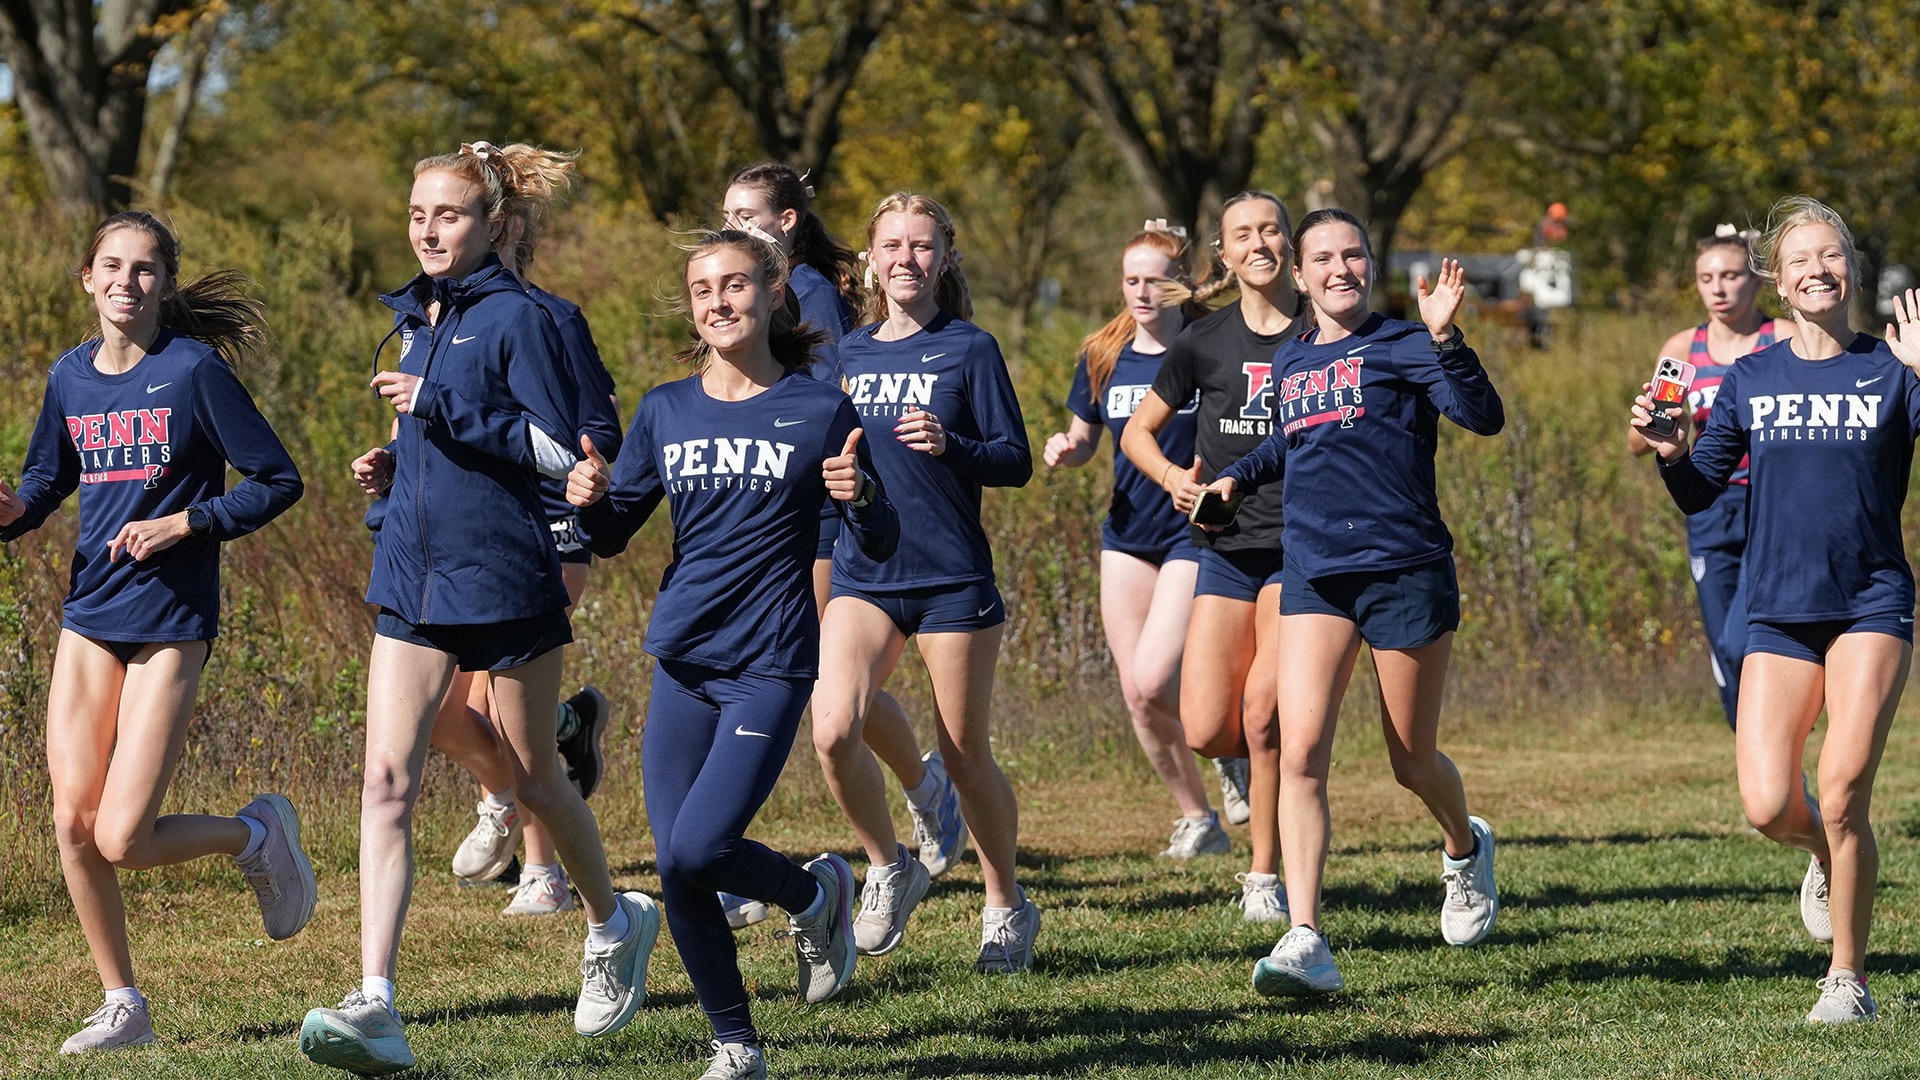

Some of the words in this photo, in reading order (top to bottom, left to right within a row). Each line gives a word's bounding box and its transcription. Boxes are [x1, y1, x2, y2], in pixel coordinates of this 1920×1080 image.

[1749, 393, 1883, 431] PENN
[1219, 418, 1254, 435] TRACK
[1257, 420, 1266, 436] &
[1759, 428, 1868, 442] ATHLETICS
[663, 437, 796, 481] PENN
